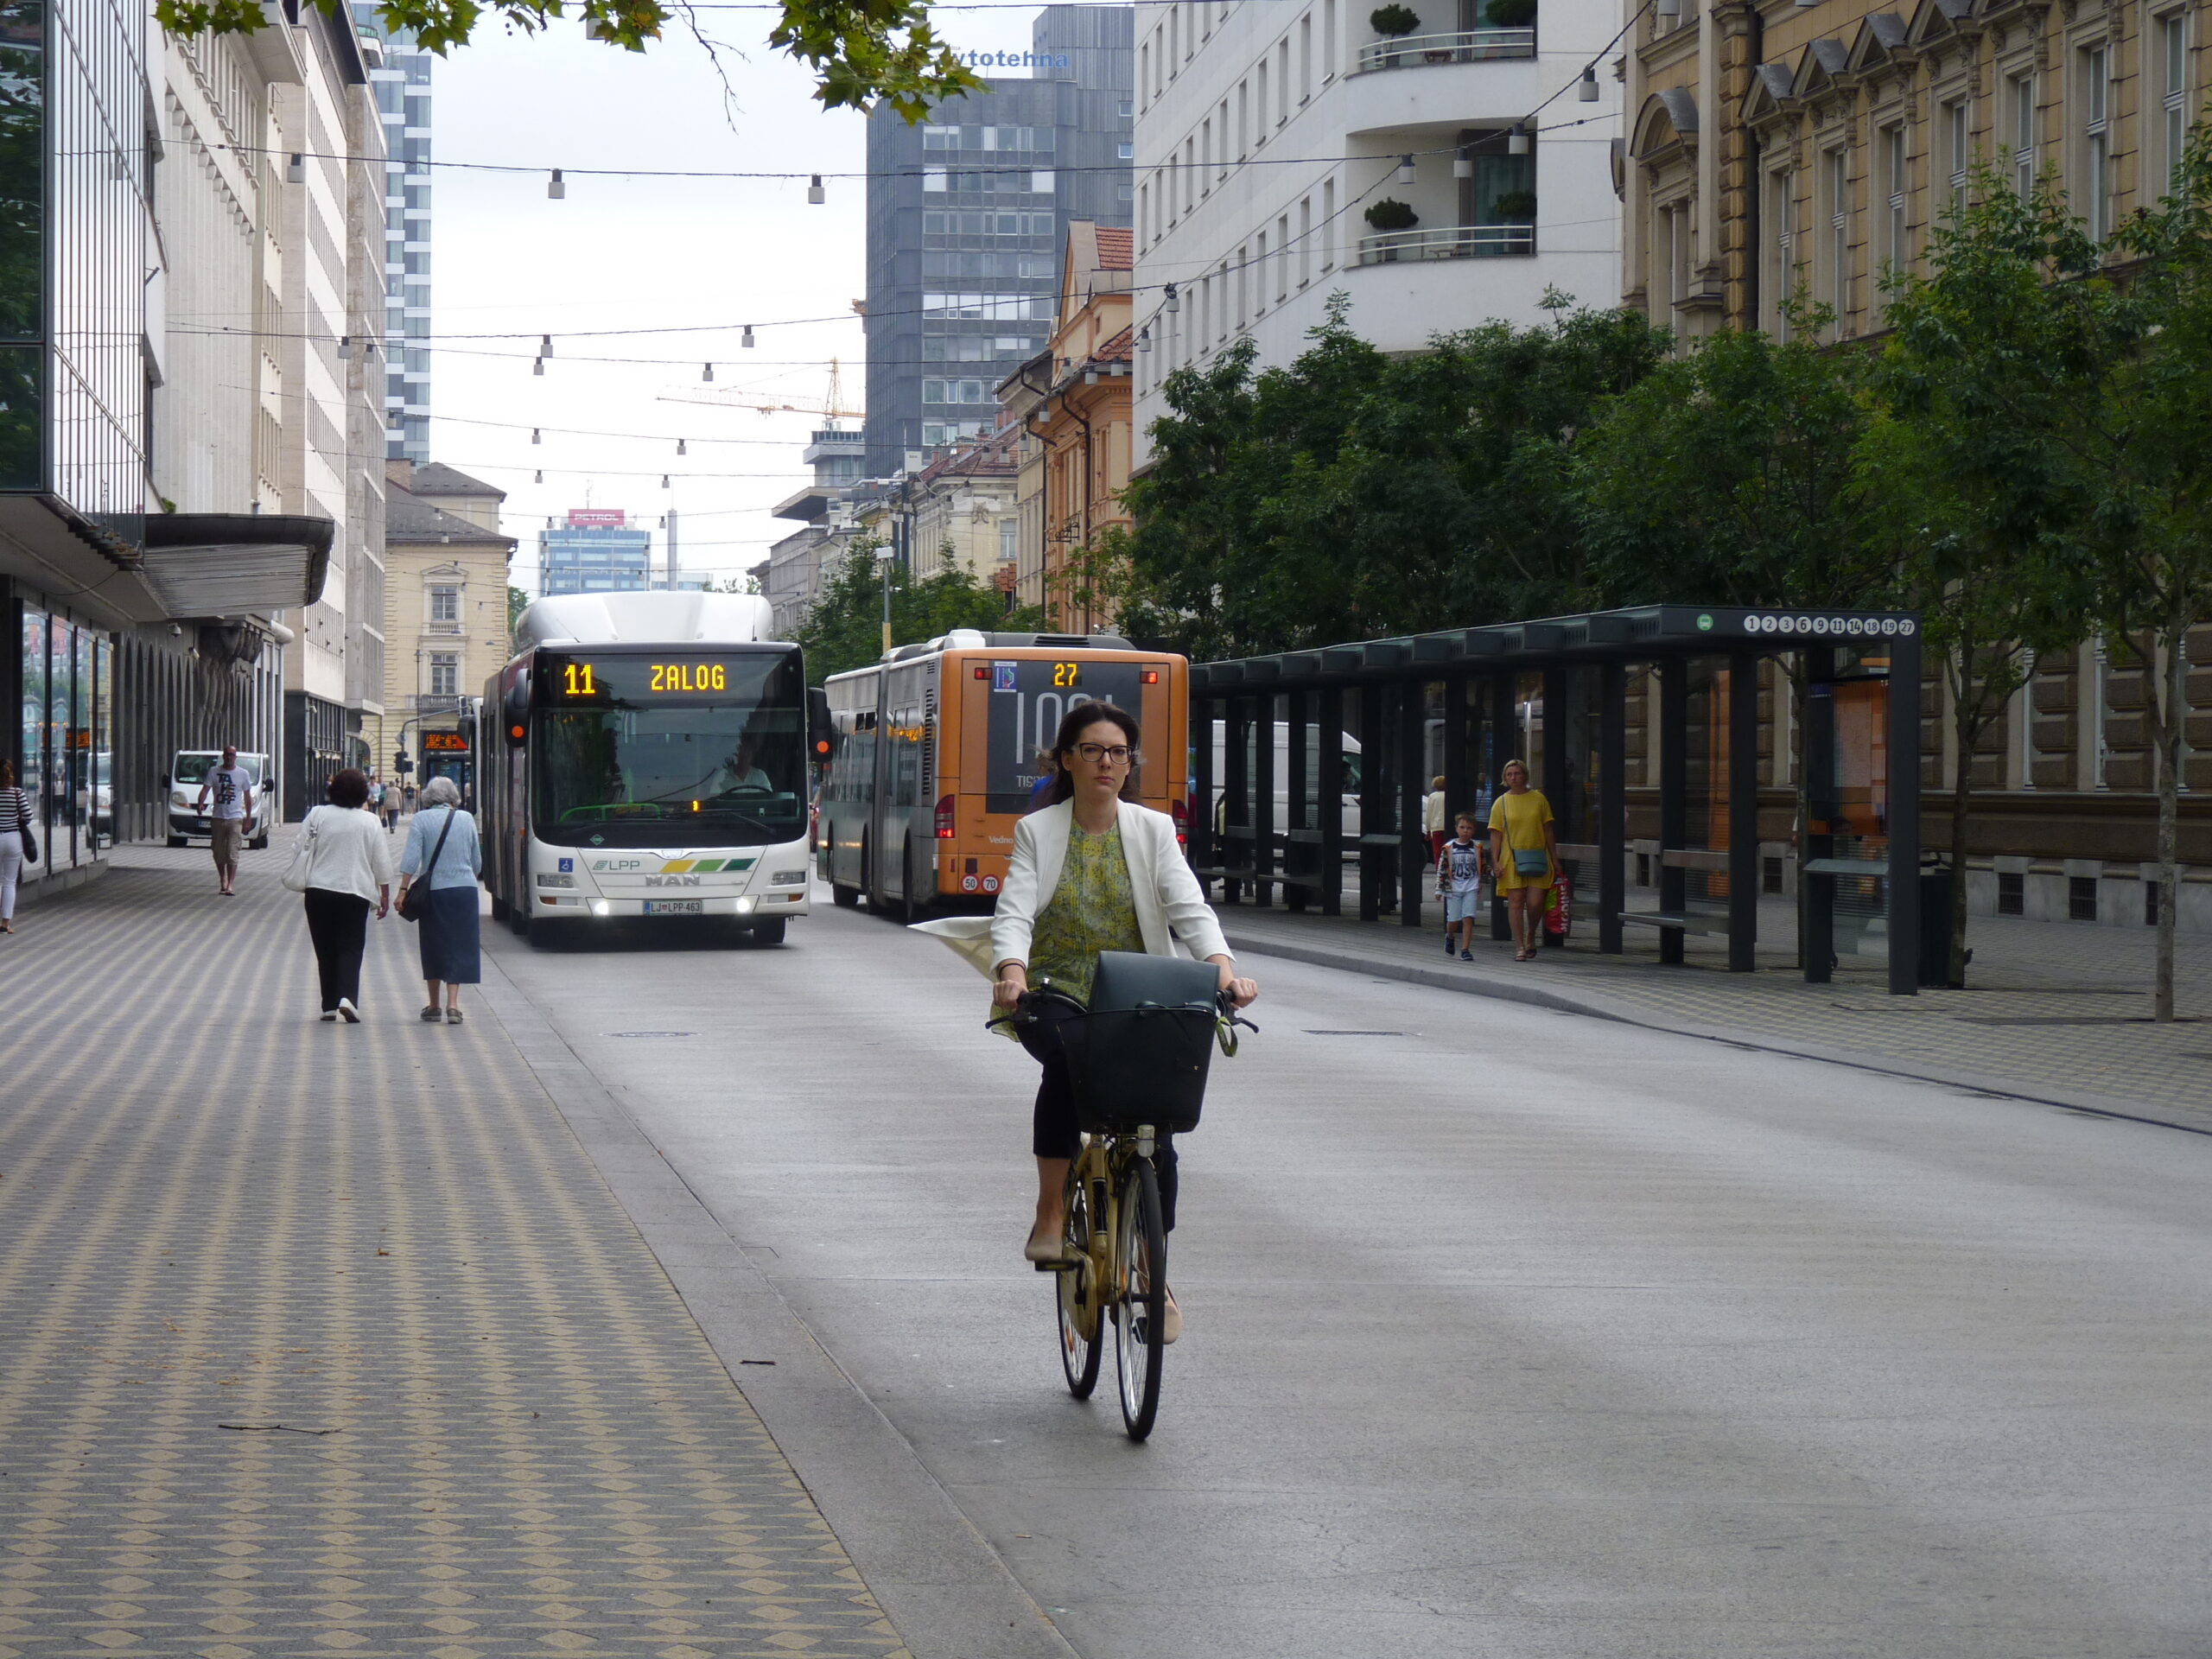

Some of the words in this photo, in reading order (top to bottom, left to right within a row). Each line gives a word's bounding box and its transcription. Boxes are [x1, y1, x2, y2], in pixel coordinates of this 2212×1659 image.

[938, 49, 1068, 67] vtotehna
[1749, 618, 1754, 629] 1
[1766, 620, 1772, 629] 2
[1783, 620, 1789, 630] 3
[1800, 620, 1807, 631] 6
[1818, 620, 1824, 631] 9
[1833, 621, 1844, 632] 11
[1849, 620, 1861, 632] 14
[1866, 622, 1878, 632] 18
[1884, 622, 1895, 632] 19
[1901, 623, 1913, 632] 27
[564, 664, 595, 694] 11
[651, 664, 724, 690] ZALOG
[1054, 663, 1077, 685] 27
[609, 861, 640, 870] LPP
[645, 874, 700, 887] MAN
[965, 879, 976, 888] 50
[985, 879, 996, 889] 70
[651, 903, 661, 912] LJ
